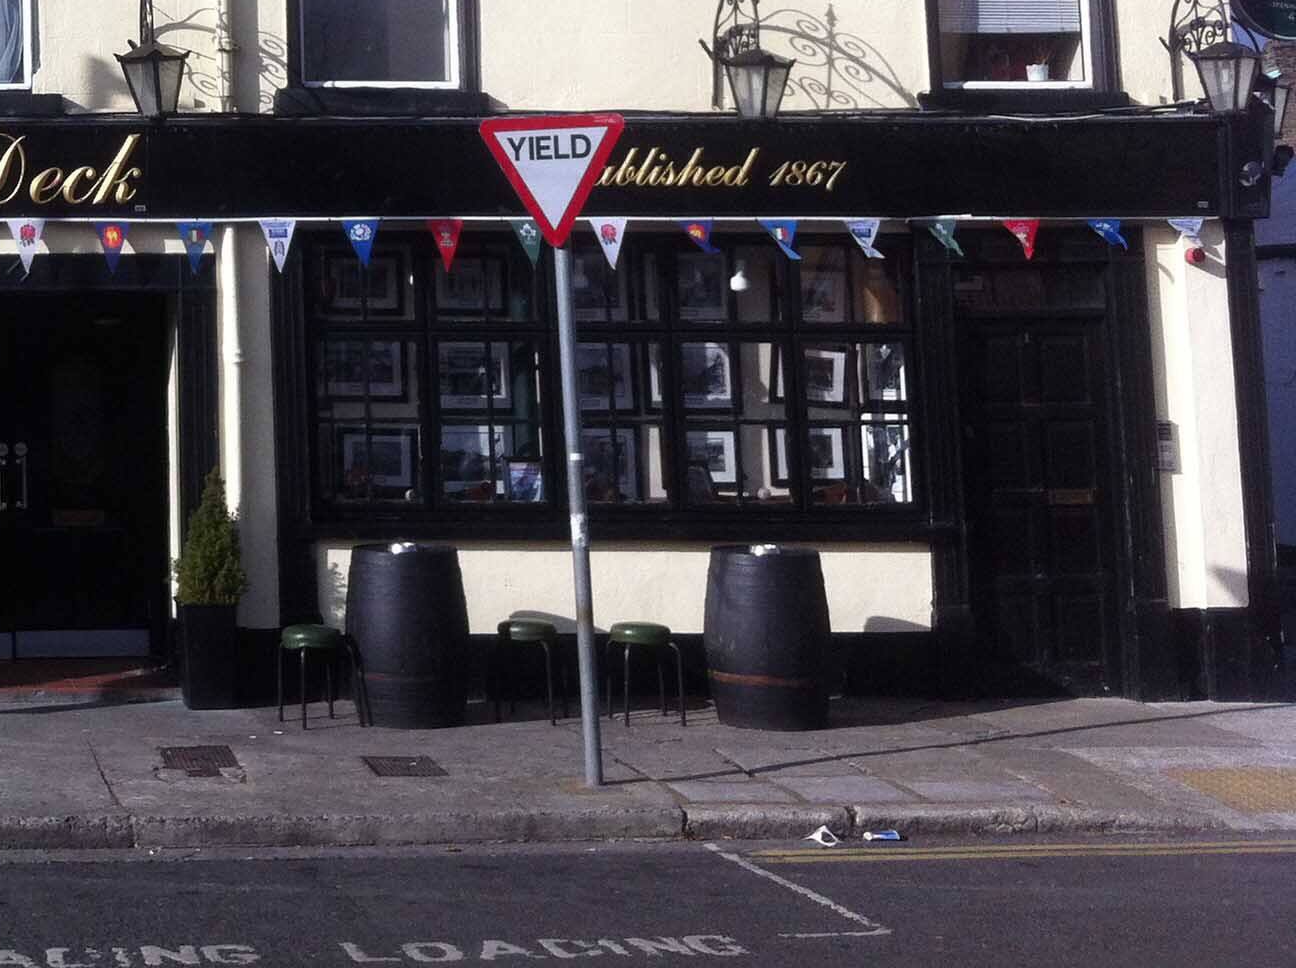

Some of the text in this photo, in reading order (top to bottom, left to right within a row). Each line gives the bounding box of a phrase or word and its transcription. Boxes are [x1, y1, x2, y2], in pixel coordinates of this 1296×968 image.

[507, 134, 591, 161] YIELD
[769, 161, 847, 191] 1867
[339, 935, 750, 963] LOADING
